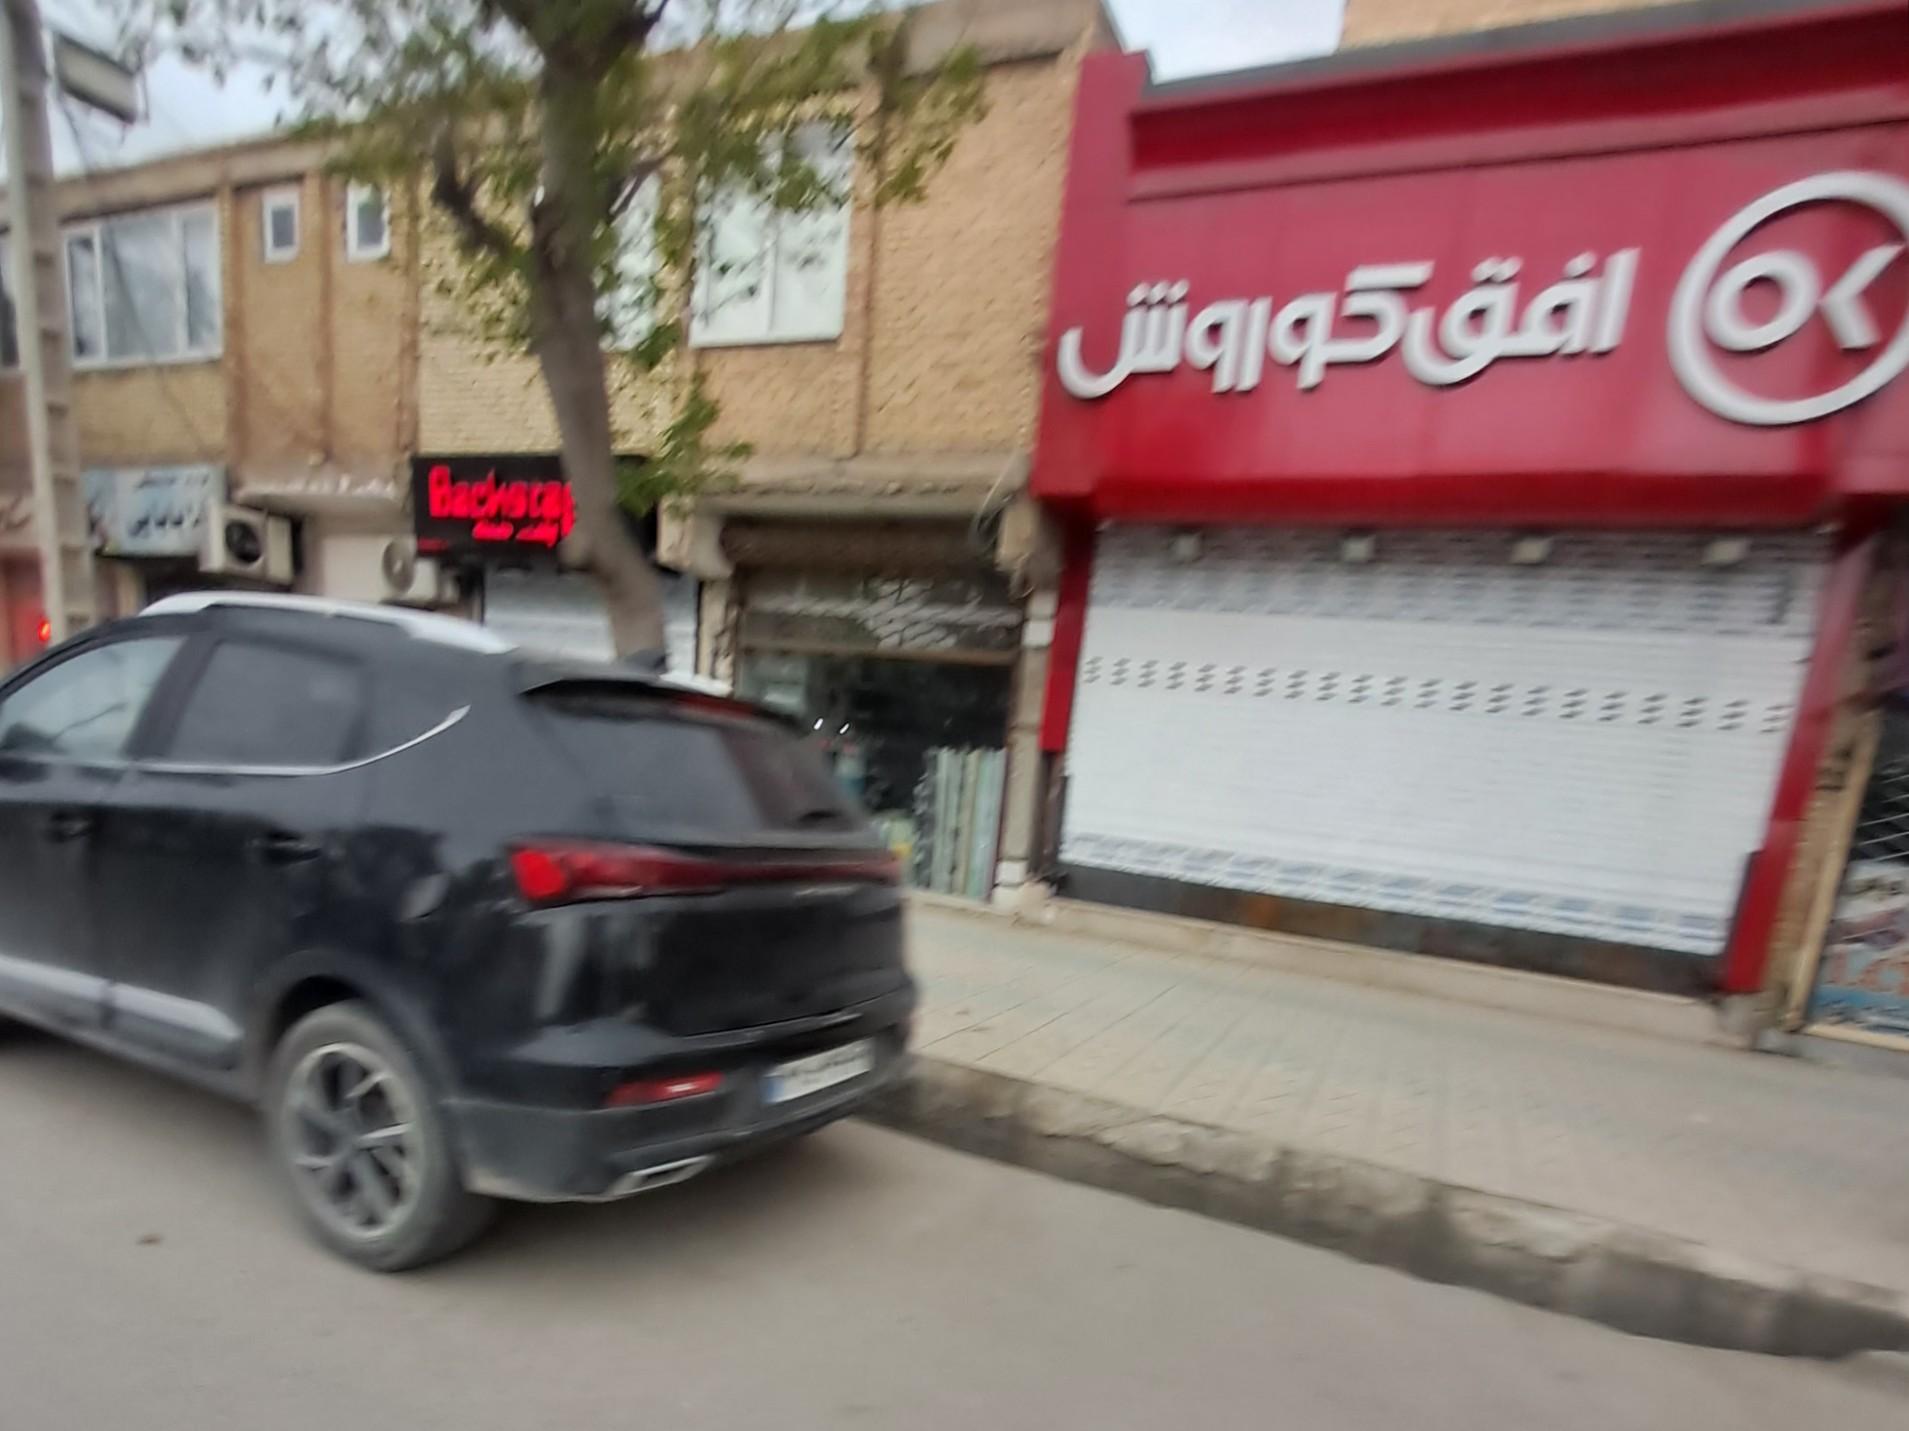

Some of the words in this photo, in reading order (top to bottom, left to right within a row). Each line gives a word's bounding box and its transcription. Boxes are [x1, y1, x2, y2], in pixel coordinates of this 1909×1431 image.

[1057, 260, 1434, 400] کوروش
[1402, 246, 1641, 387] افق
[1703, 242, 1907, 352] OK
